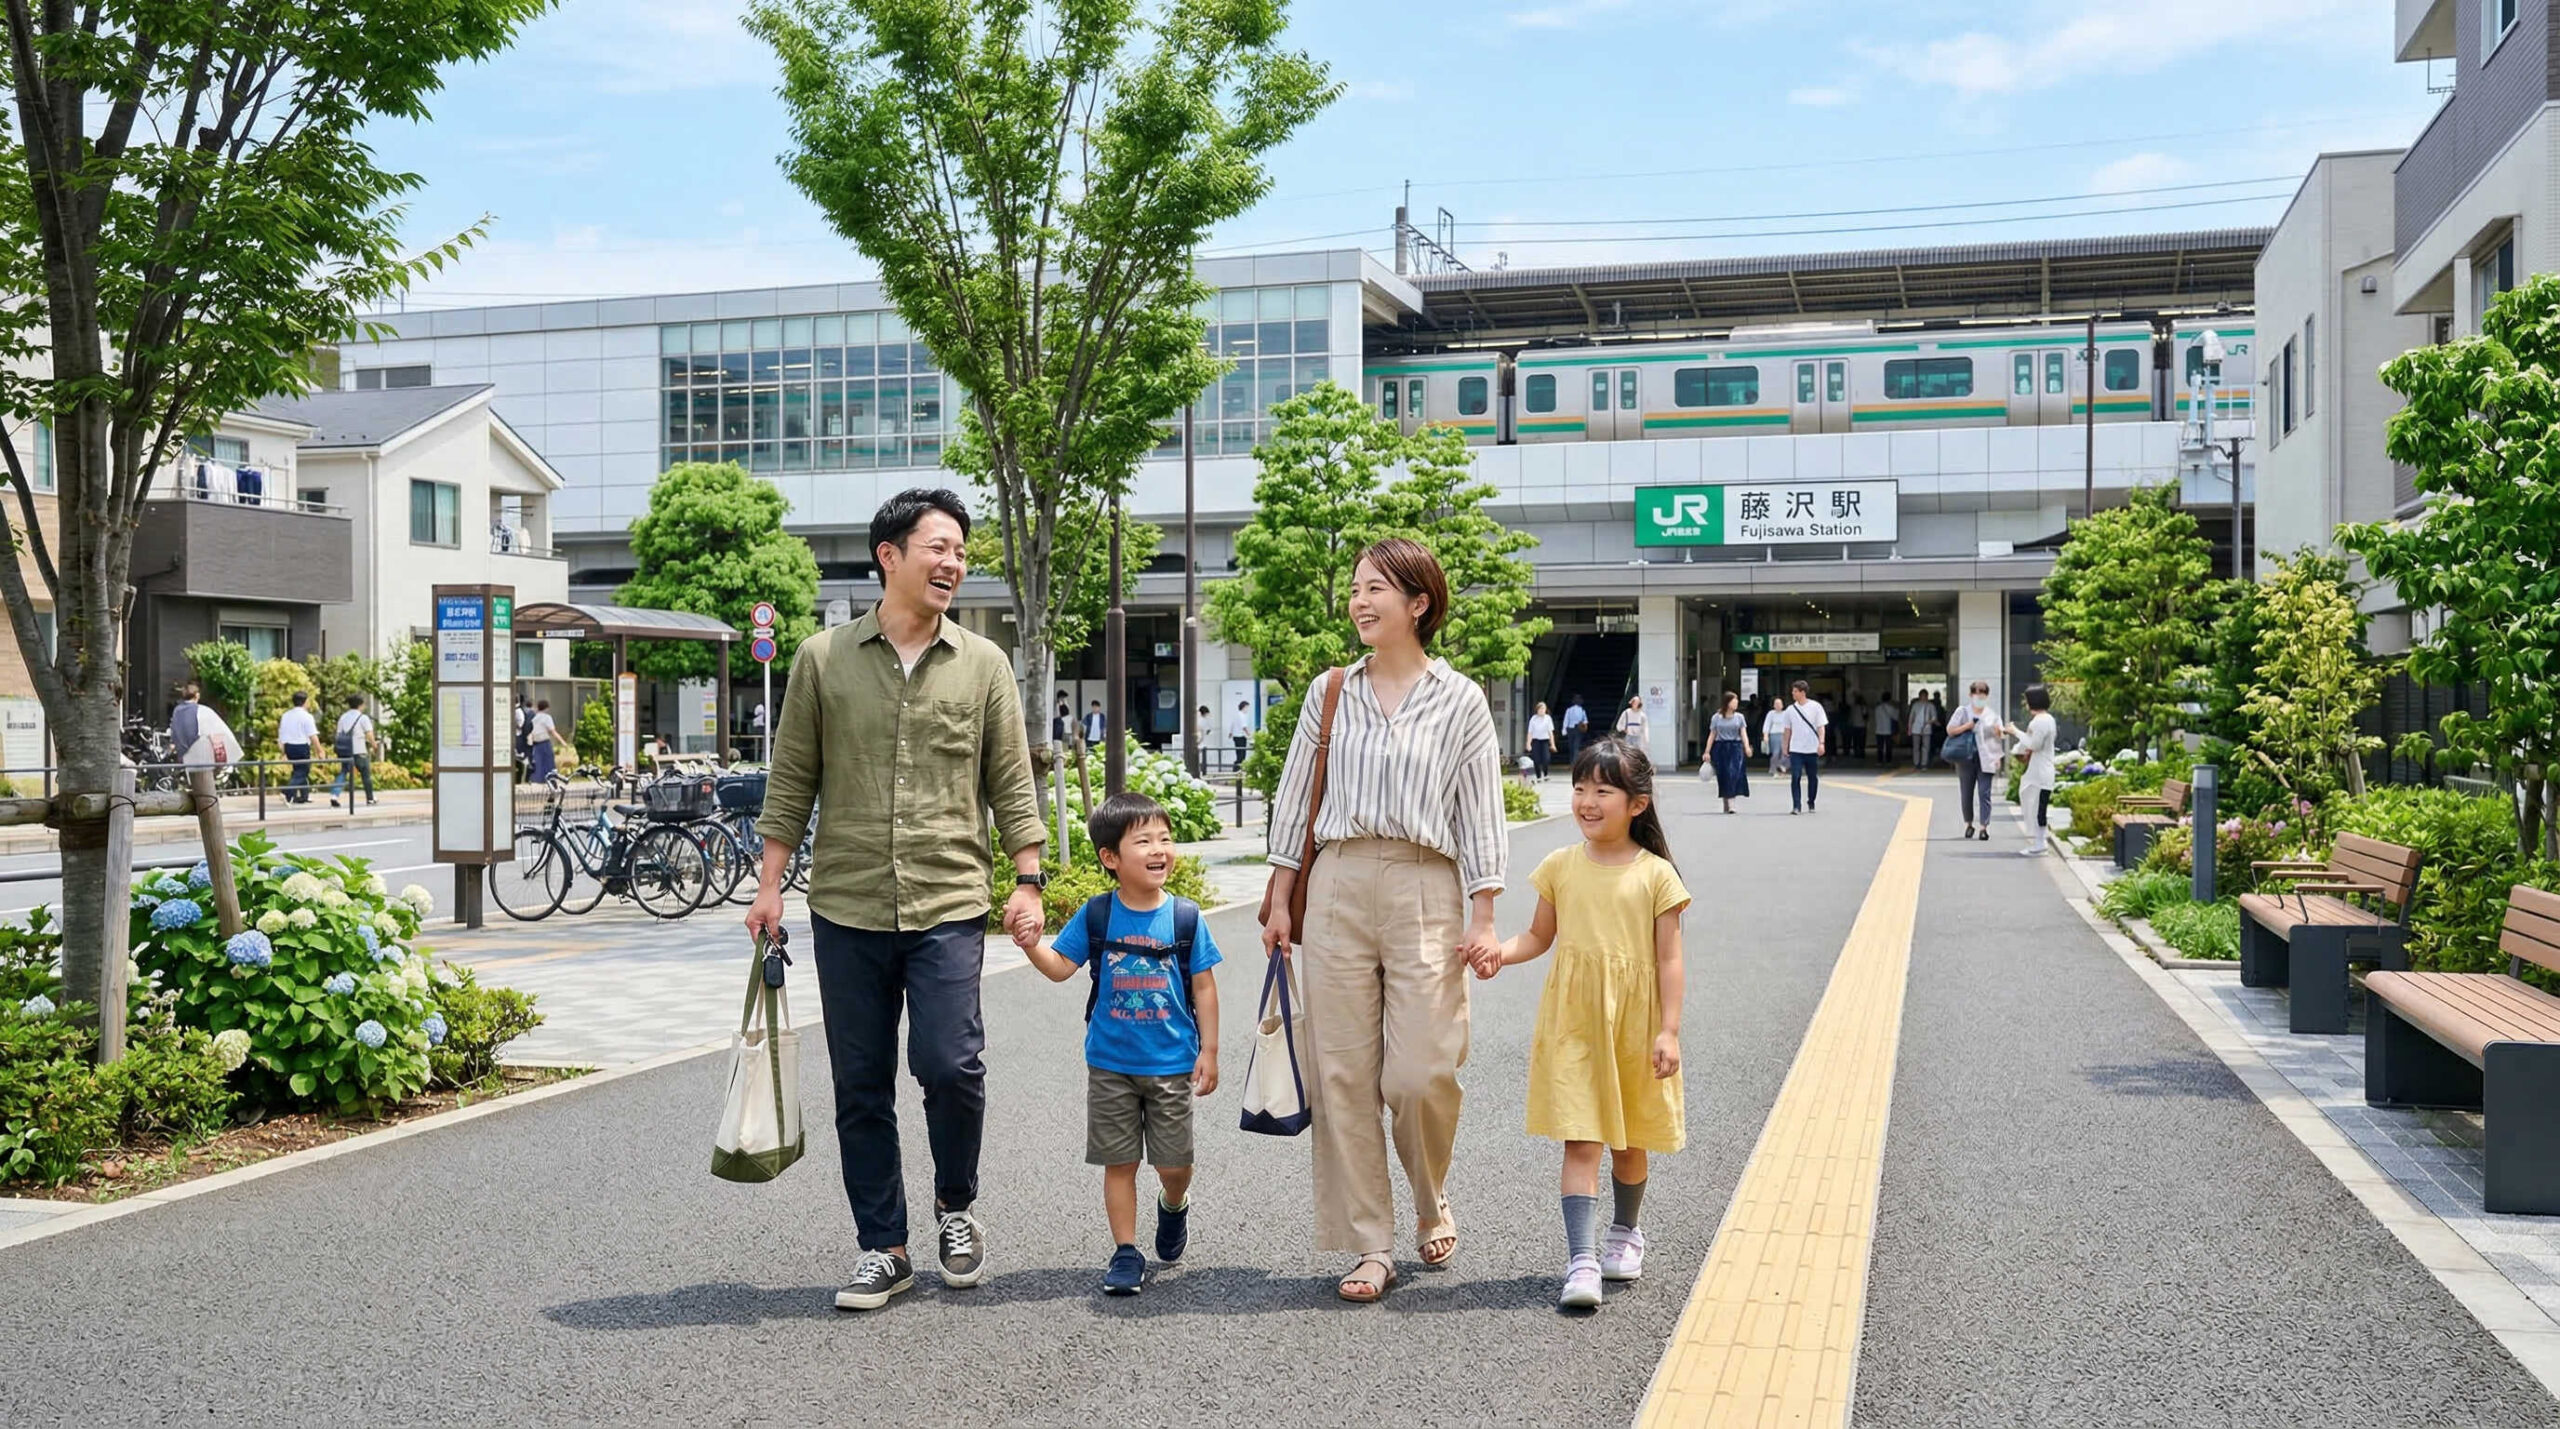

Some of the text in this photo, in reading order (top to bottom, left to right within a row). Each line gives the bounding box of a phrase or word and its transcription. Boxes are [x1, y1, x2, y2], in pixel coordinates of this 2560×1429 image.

[2227, 344, 2248, 356] JR
[1653, 494, 1709, 526] JR
[1740, 490, 1861, 520] 藤沢駅
[1741, 522, 1862, 540] Fujisawa Station
[1742, 636, 1764, 649] JR
